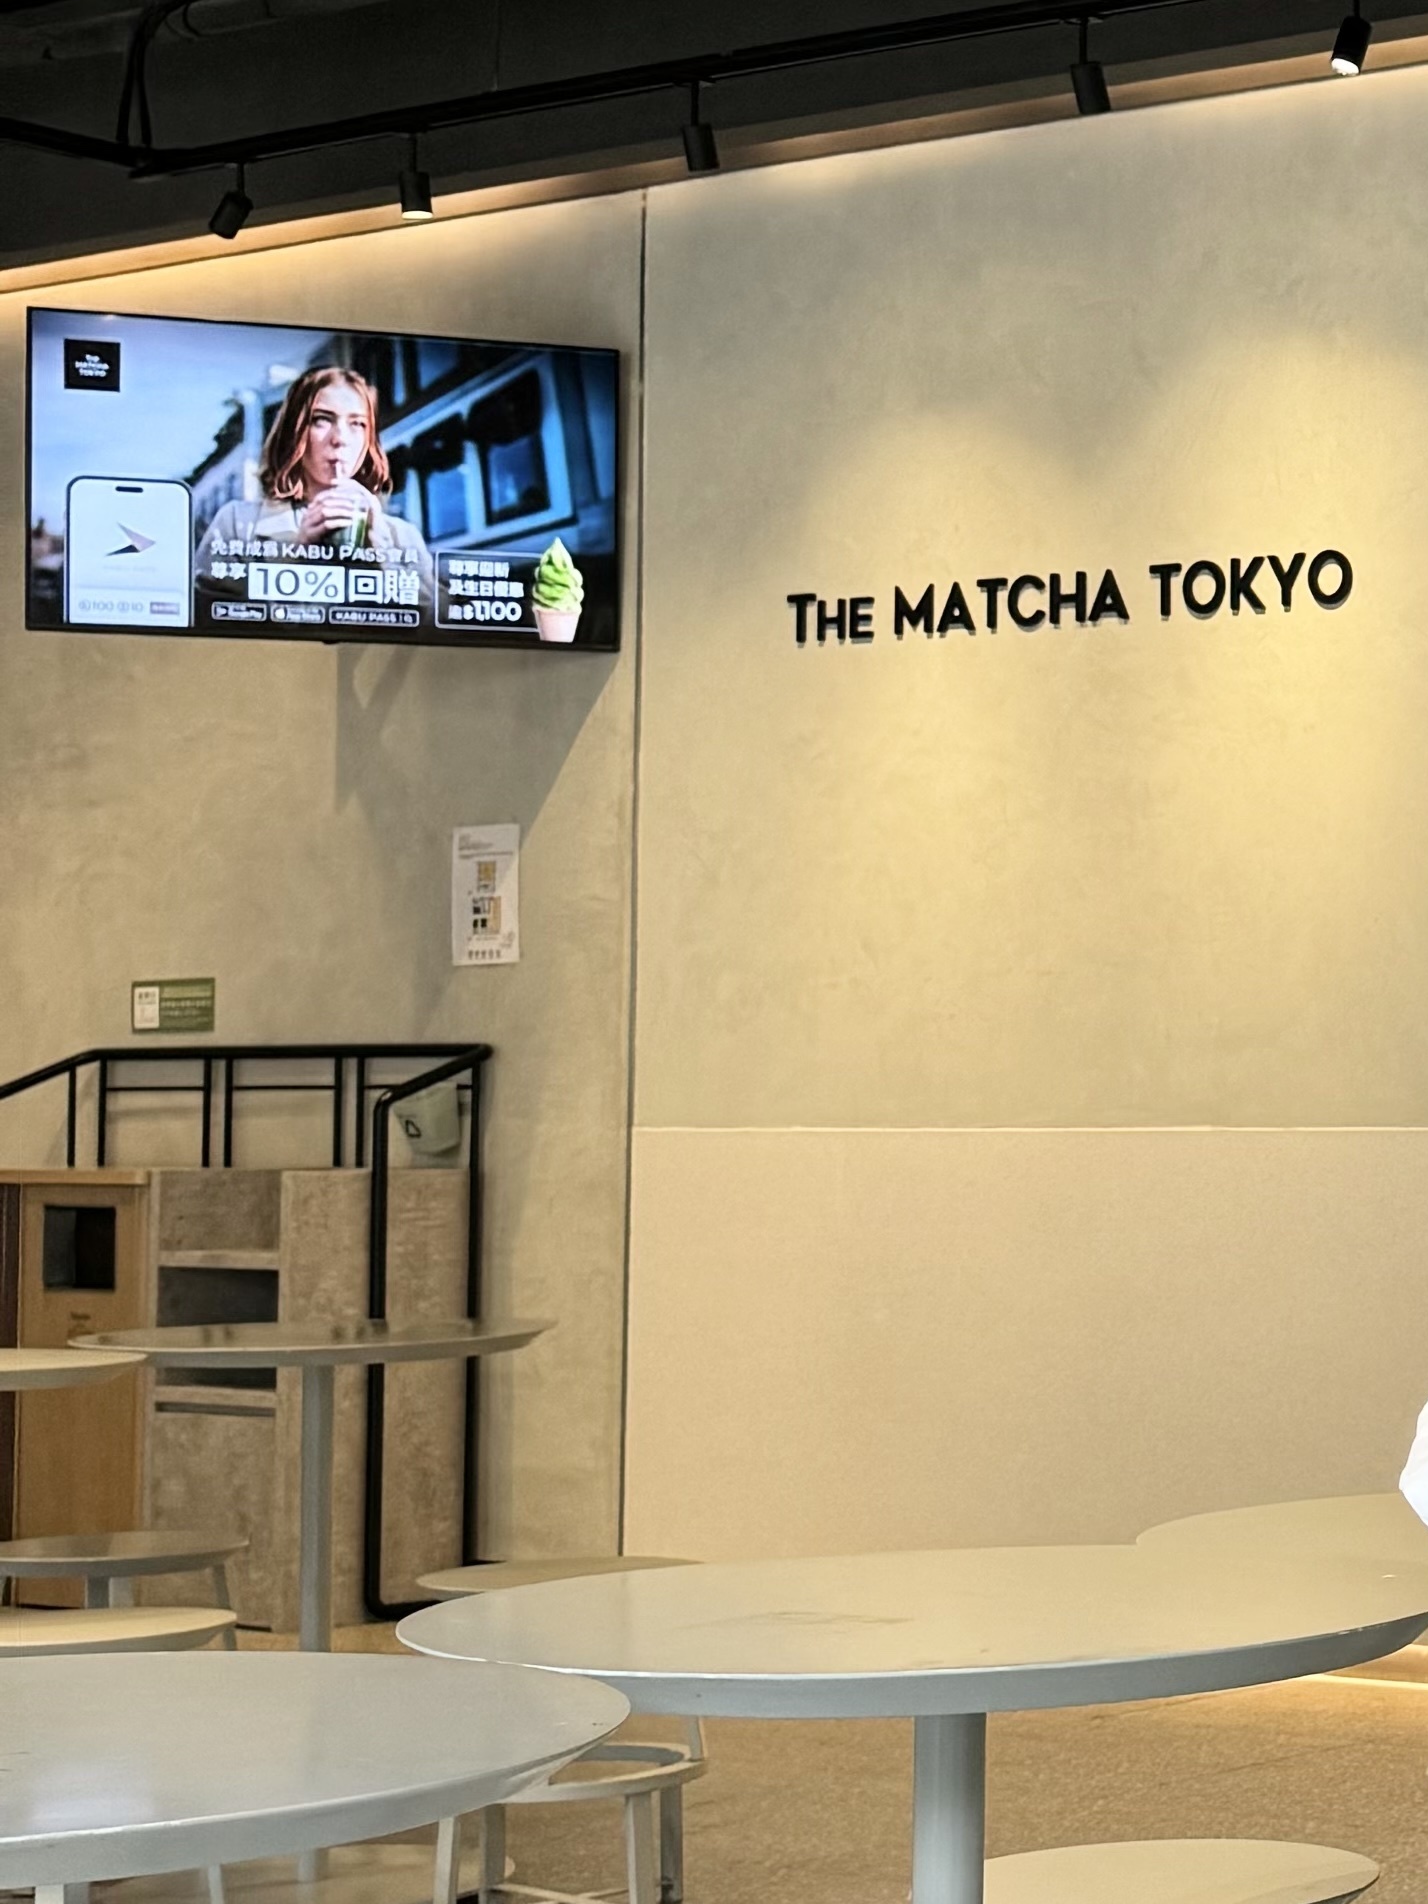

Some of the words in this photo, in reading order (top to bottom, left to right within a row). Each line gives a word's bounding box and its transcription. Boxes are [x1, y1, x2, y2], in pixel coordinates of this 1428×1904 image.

[282, 543, 333, 559] KABU
[256, 567, 339, 598] 10%
[349, 569, 419, 605] 回贈
[787, 594, 875, 644] THE
[895, 570, 1130, 638] MATCHA
[1150, 550, 1353, 618] TOKYO
